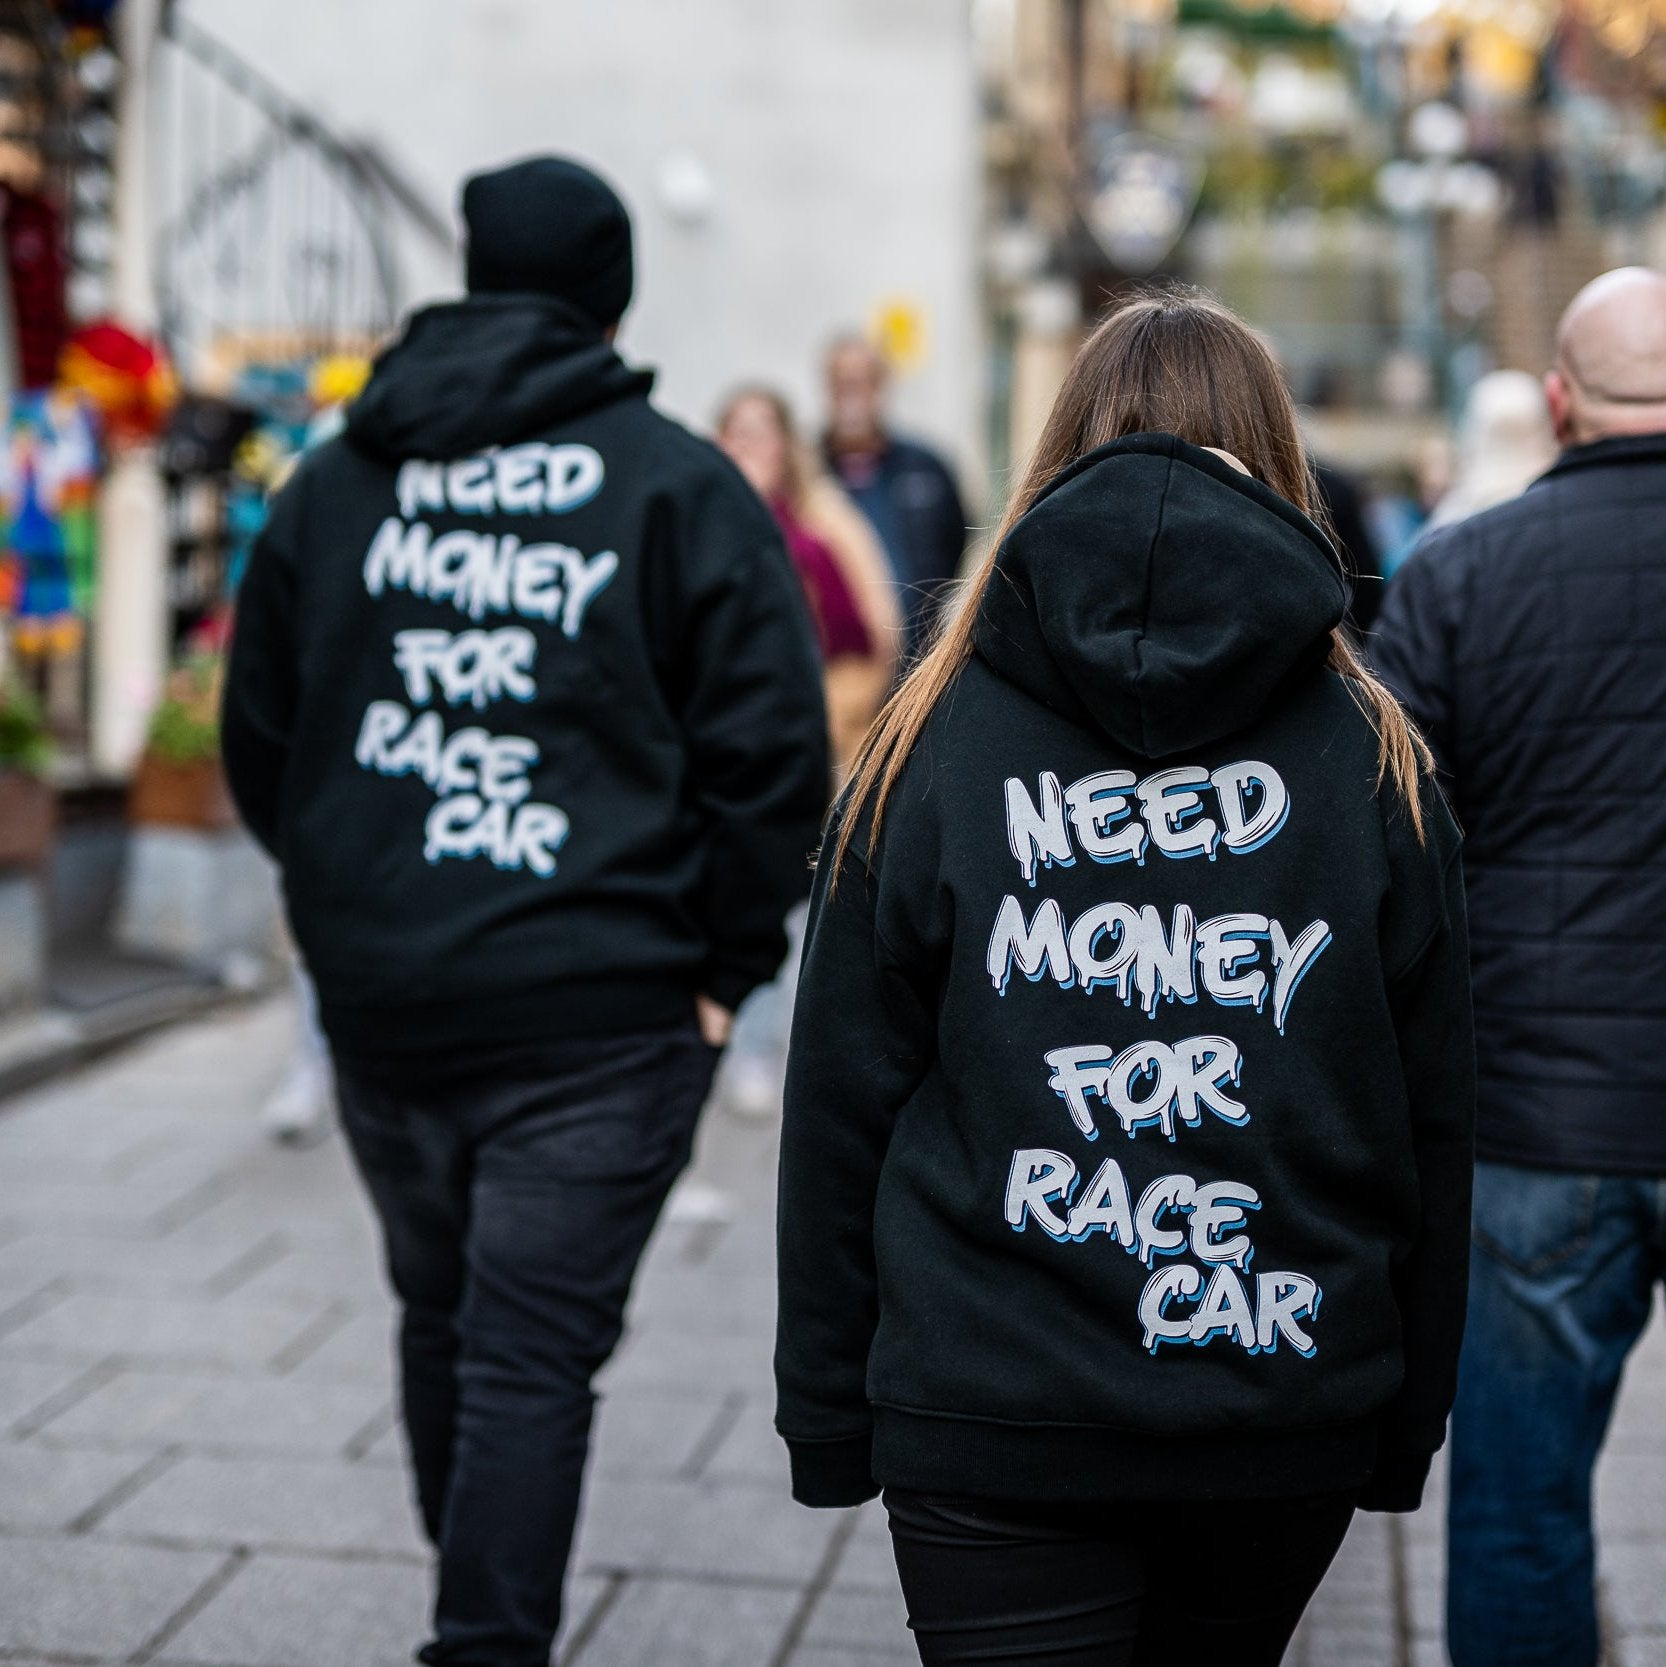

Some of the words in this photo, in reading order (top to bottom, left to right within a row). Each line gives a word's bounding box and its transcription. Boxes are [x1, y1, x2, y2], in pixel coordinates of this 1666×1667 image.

[396, 442, 605, 518] NEED
[363, 517, 619, 638] MONEY
[393, 626, 537, 710] FOR
[355, 700, 540, 802] RACE
[423, 794, 569, 878] CAR
[1004, 760, 1290, 887] NEED
[987, 894, 1332, 1036] MONEY
[1043, 1035, 1251, 1142] FOR
[1005, 1148, 1262, 1274] RACE
[1138, 1264, 1322, 1358] CAR
